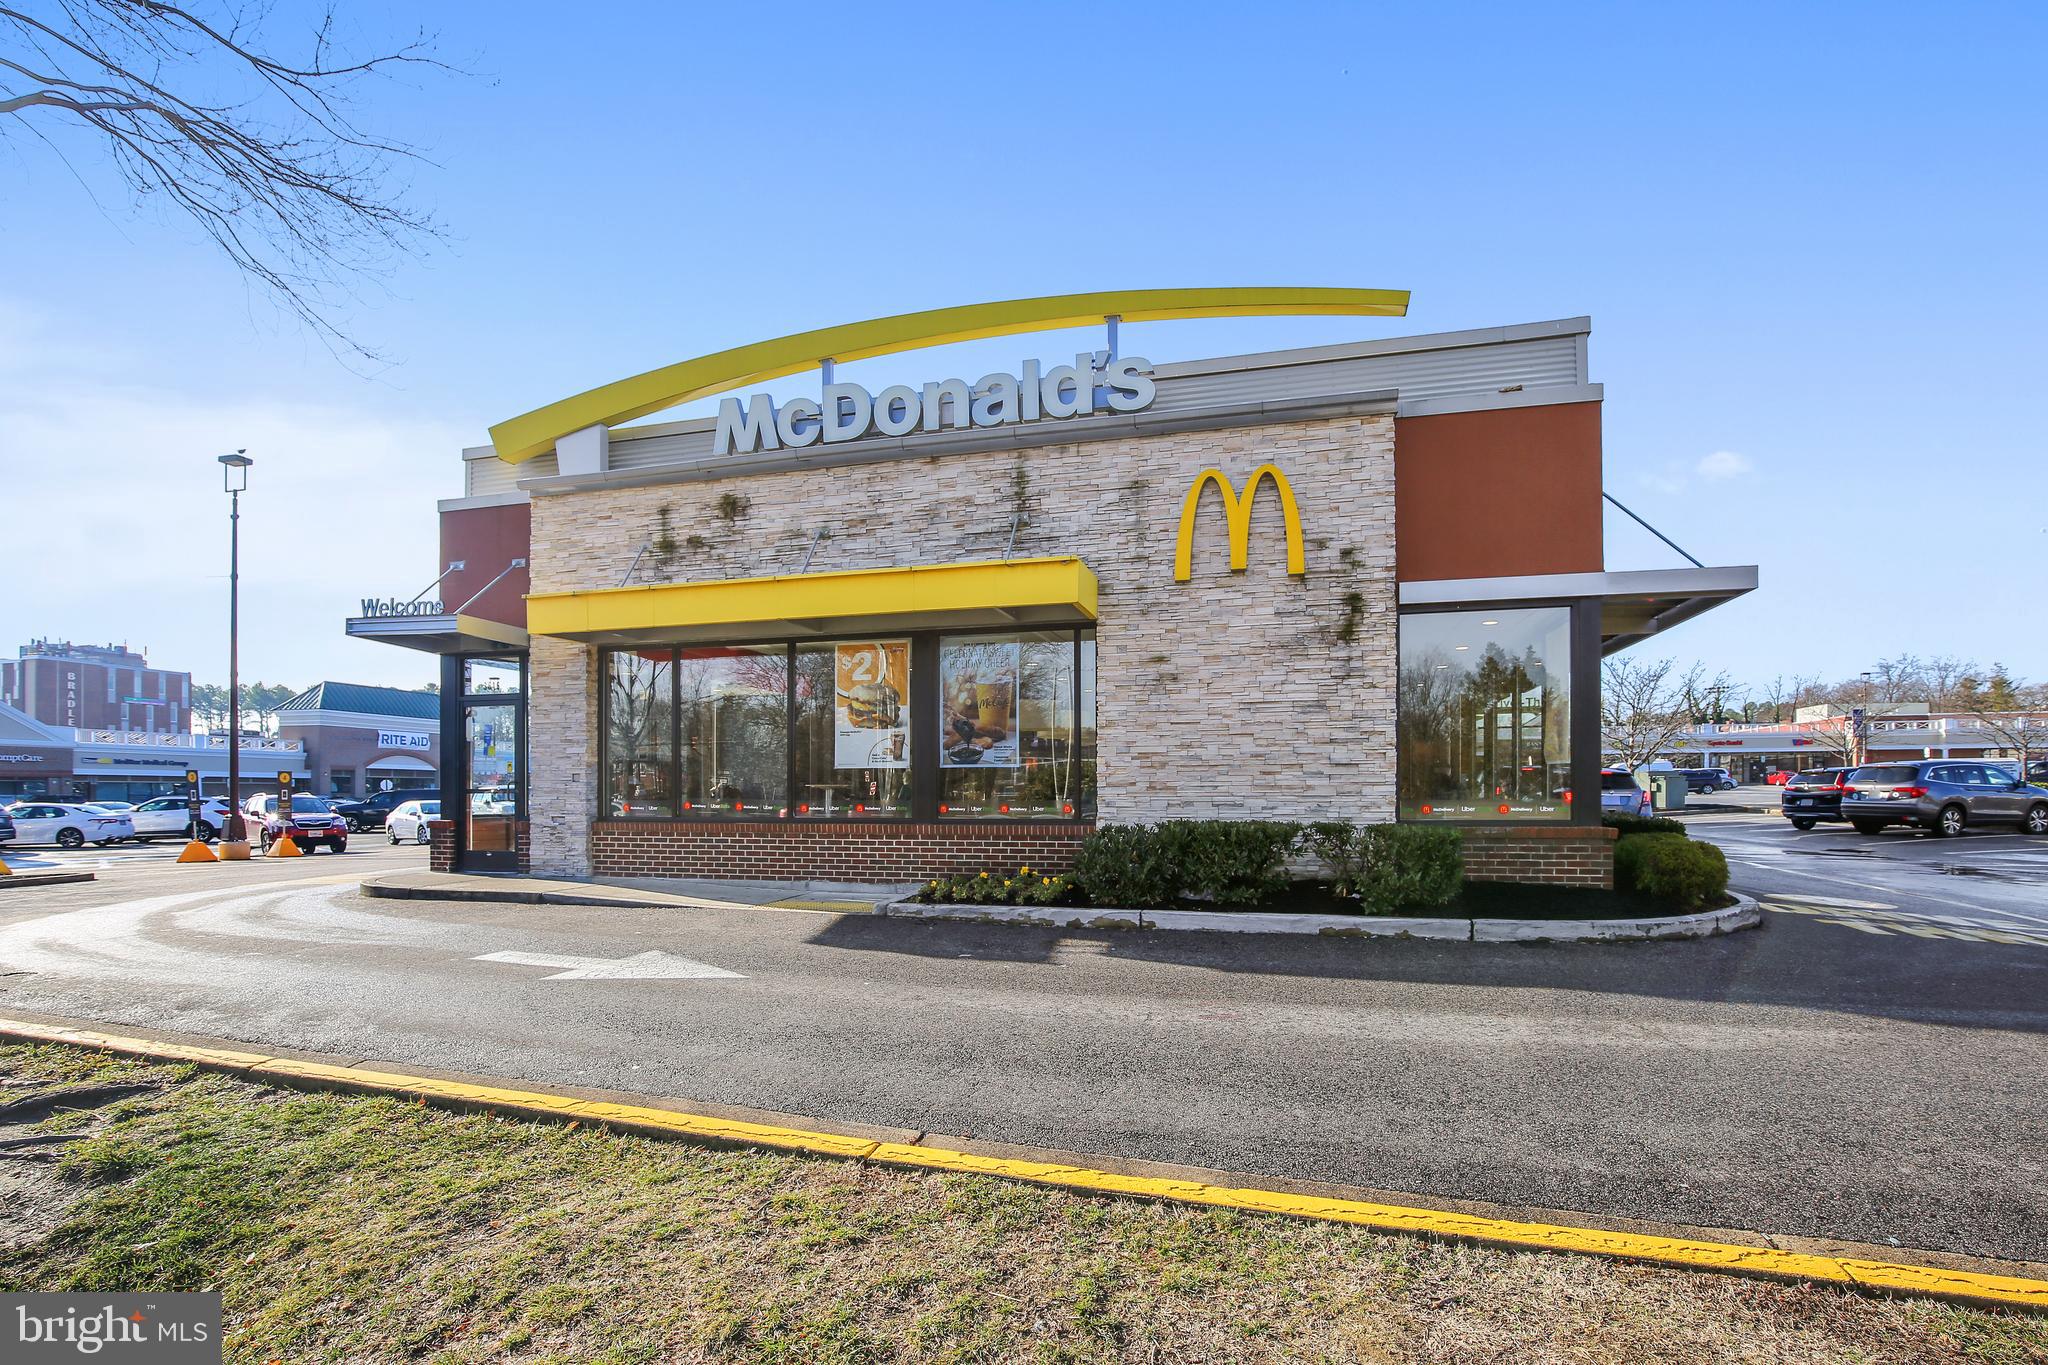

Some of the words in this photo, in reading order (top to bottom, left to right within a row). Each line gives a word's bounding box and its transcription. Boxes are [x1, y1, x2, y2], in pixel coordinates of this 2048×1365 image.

[713, 350, 1157, 456] McDonald's
[360, 597, 445, 618] Welcome
[841, 651, 872, 681] $2
[381, 733, 407, 745] RITE
[409, 736, 429, 747] AID
